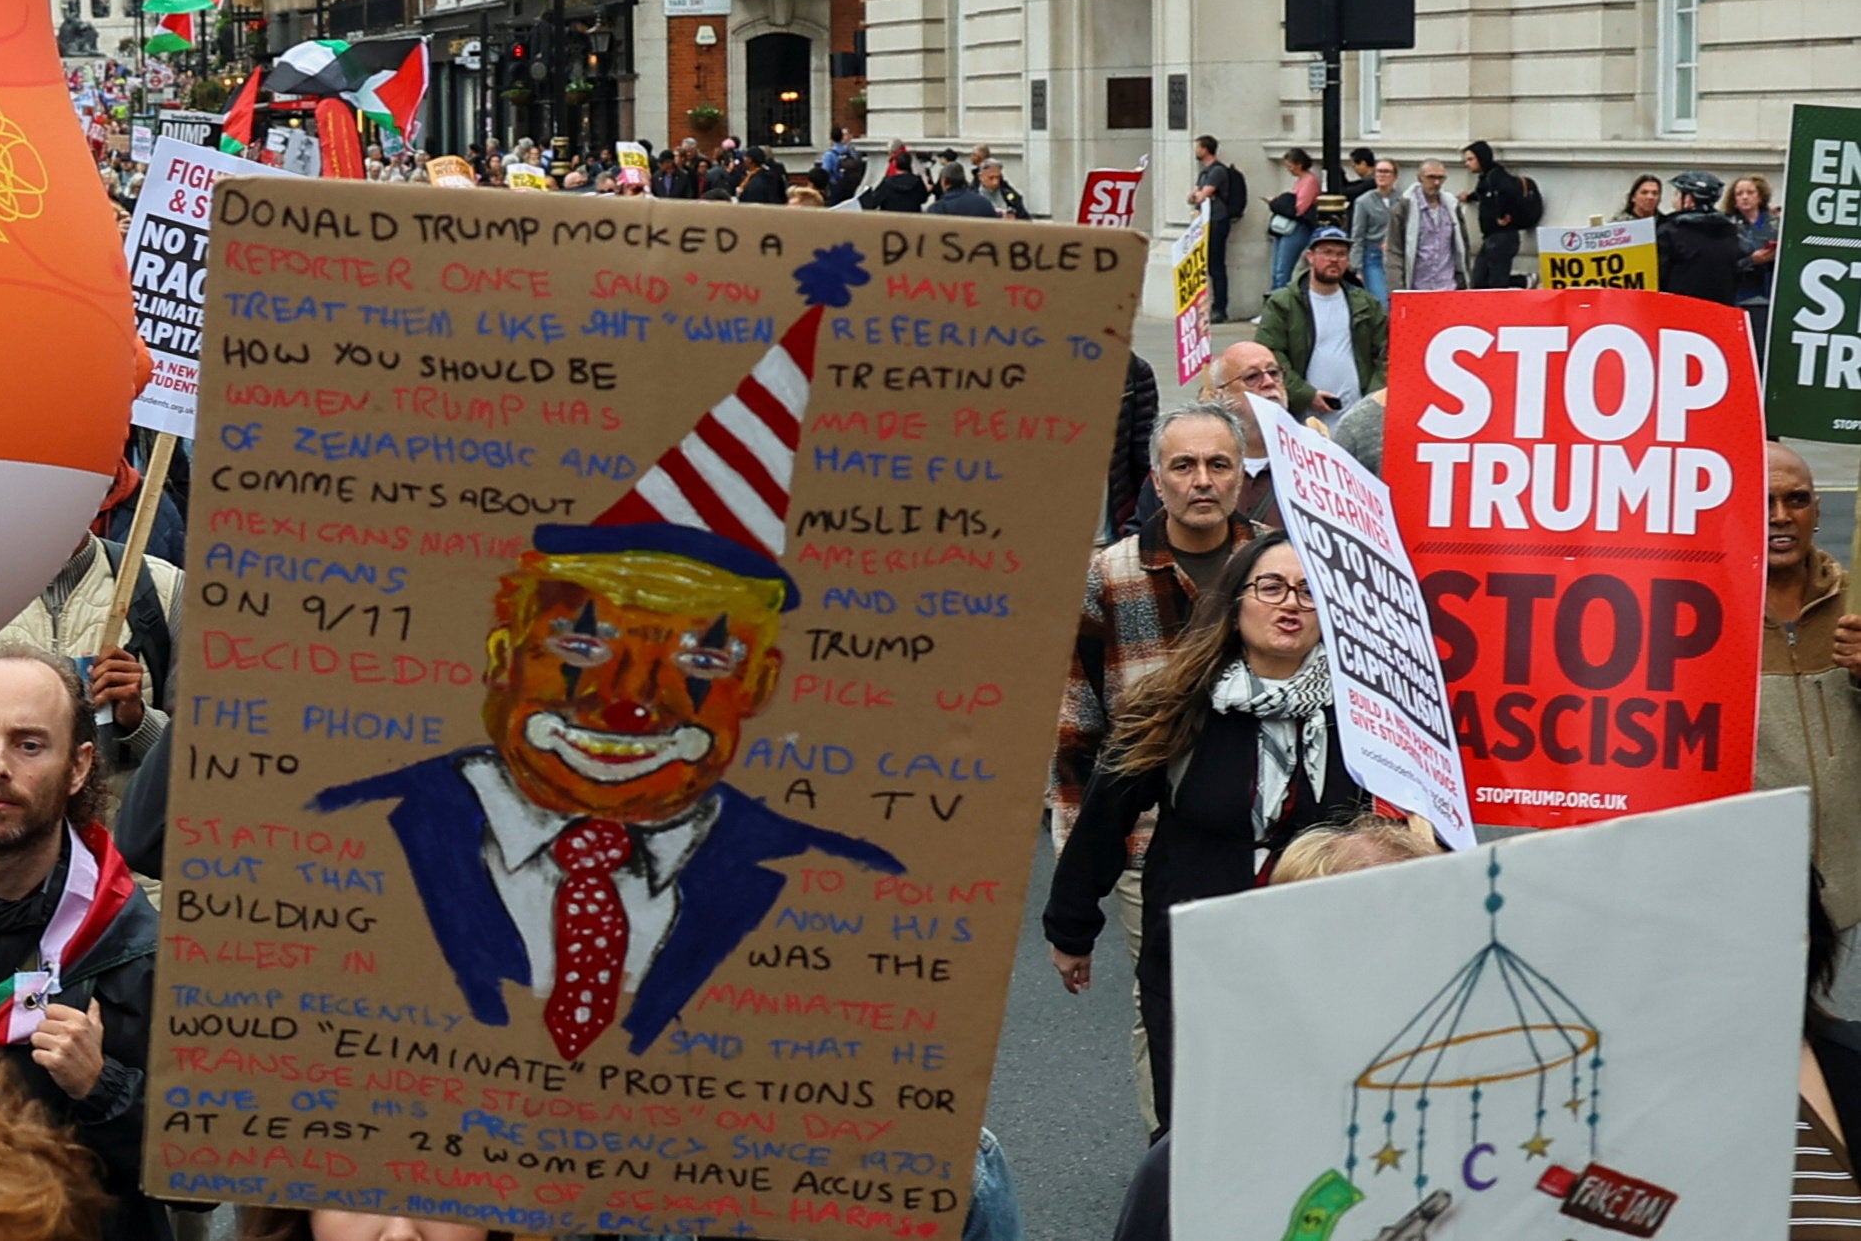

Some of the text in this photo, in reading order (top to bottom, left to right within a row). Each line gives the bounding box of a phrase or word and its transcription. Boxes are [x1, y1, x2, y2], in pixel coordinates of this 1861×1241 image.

[162, 122, 211, 145] DUMP
[141, 221, 186, 258] NO
[219, 190, 399, 242] DONALD
[413, 214, 539, 247] TRUMP
[553, 218, 739, 256] MOCKED
[760, 232, 784, 257] A
[883, 230, 1120, 273] DISABLED
[1550, 253, 1624, 278] NO TO
[1583, 230, 1611, 240] STAND
[1599, 236, 1632, 247] RACISM
[224, 240, 1046, 312] REPORTER ONCE SAID HAVE TO
[224, 292, 1047, 348] TREAT LIKE REFERING
[224, 336, 310, 367] HOW
[335, 341, 401, 370] YOU
[420, 355, 555, 385] SHOULD
[569, 358, 618, 391] BE
[828, 363, 1027, 391] TREATING
[1417, 323, 1728, 443] STOP
[225, 384, 1089, 444] WOMEN TRUMP HAS MADE PLENTY
[212, 465, 1003, 539] COMMENTS ABOUT MUSLIMS,
[561, 447, 1005, 484] AND HATEFUL
[1276, 424, 1385, 521] FIGHT TRUMP
[1417, 442, 1733, 536] TRUMP
[209, 508, 1023, 575] MEXICANS AMERICANS
[1312, 483, 1394, 556] STARMER
[205, 542, 1012, 619] AFRICANS AND JEWS
[1294, 511, 1421, 611] NO WAR
[201, 581, 935, 662] ON 9/11 TRUMP
[1308, 555, 1435, 672] RACISM
[1421, 570, 1724, 692] STOP
[790, 673, 1004, 714] PICK UP
[1338, 634, 1448, 740] CAPITALISM
[190, 744, 300, 781] INTO
[191, 694, 998, 781] THE PHONE AND CALL
[1475, 785, 1628, 812] STOPTRUMP.ORG.UK
[174, 816, 1003, 907] STATION TO POINT
[177, 889, 953, 983] BUILDING WAS THE
[182, 856, 975, 944] OUT THAT NOW HIS
[164, 934, 939, 1032] TALLEST MANHATTEN
[169, 984, 284, 1011] TRUMP
[168, 1014, 956, 1115] WOULD PROTECTIONS FOR
[171, 1045, 896, 1142] TRANSGENDER DAY
[162, 1142, 520, 1203] DONALD TRUMP
[164, 1111, 958, 1215] AT LEAST 28 WOMEN HAVE ACCUSED
[731, 1134, 833, 1168] SINCE
[1570, 1174, 1672, 1229] FAKE TAN
